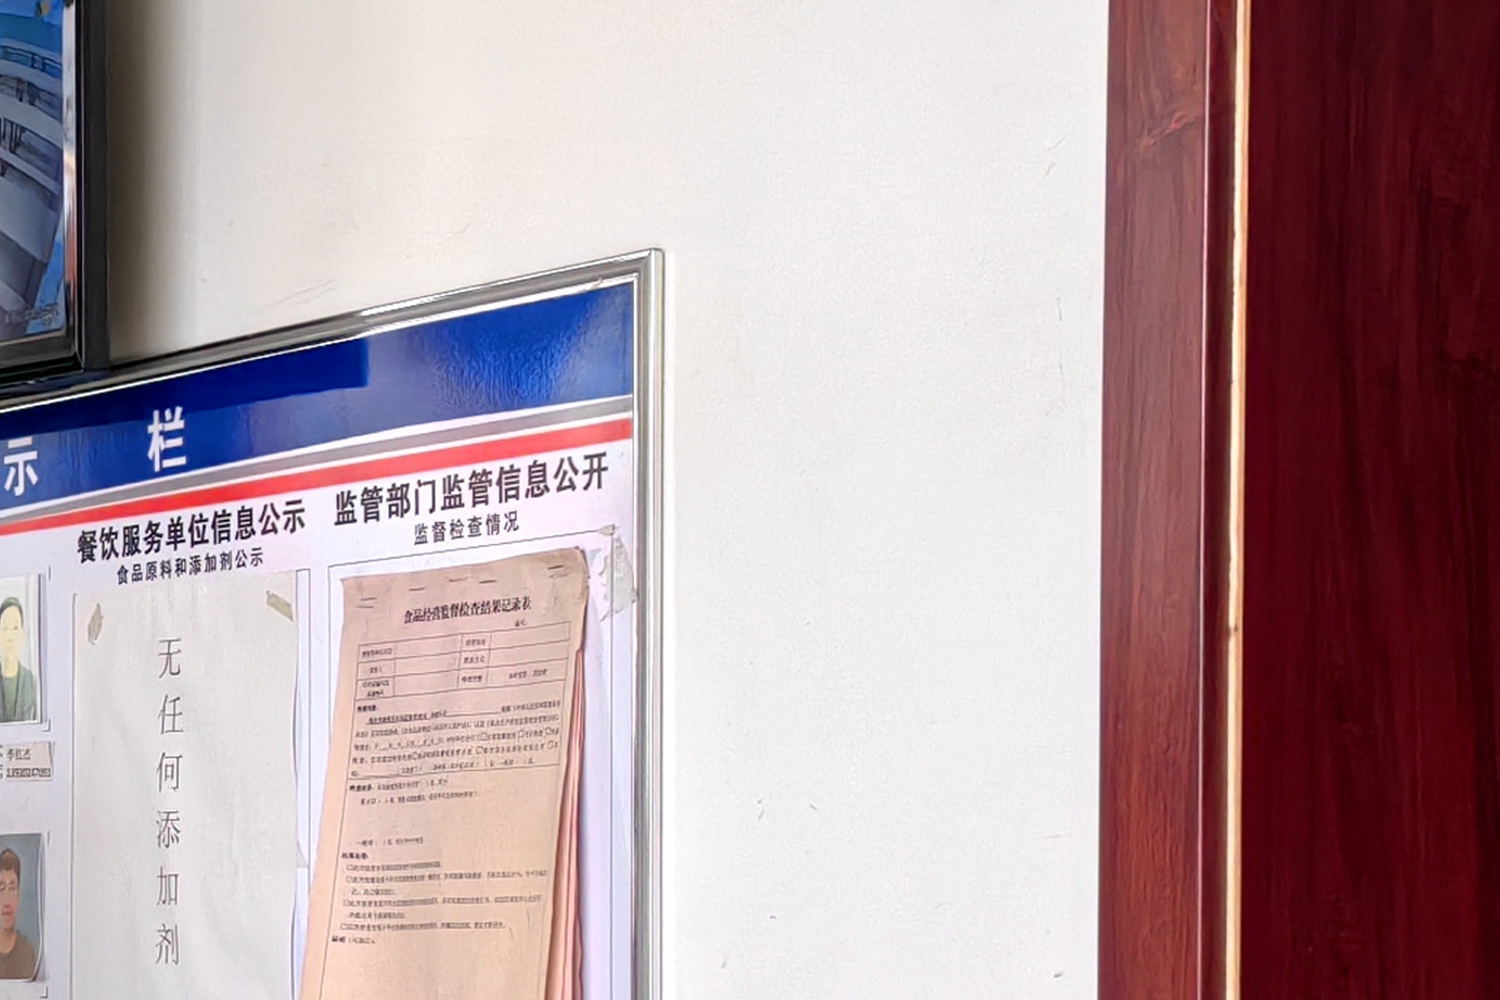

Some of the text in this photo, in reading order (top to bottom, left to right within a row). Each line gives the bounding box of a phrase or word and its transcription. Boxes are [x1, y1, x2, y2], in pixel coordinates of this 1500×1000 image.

[334, 450, 610, 526] 监管部门监管信息公开
[76, 498, 306, 563] 餐饮服务单位信息公示
[414, 510, 520, 545] 监督检查情况
[117, 546, 264, 585] 食品原料和添加剂公示
[155, 637, 184, 966] 无任何添加剂
